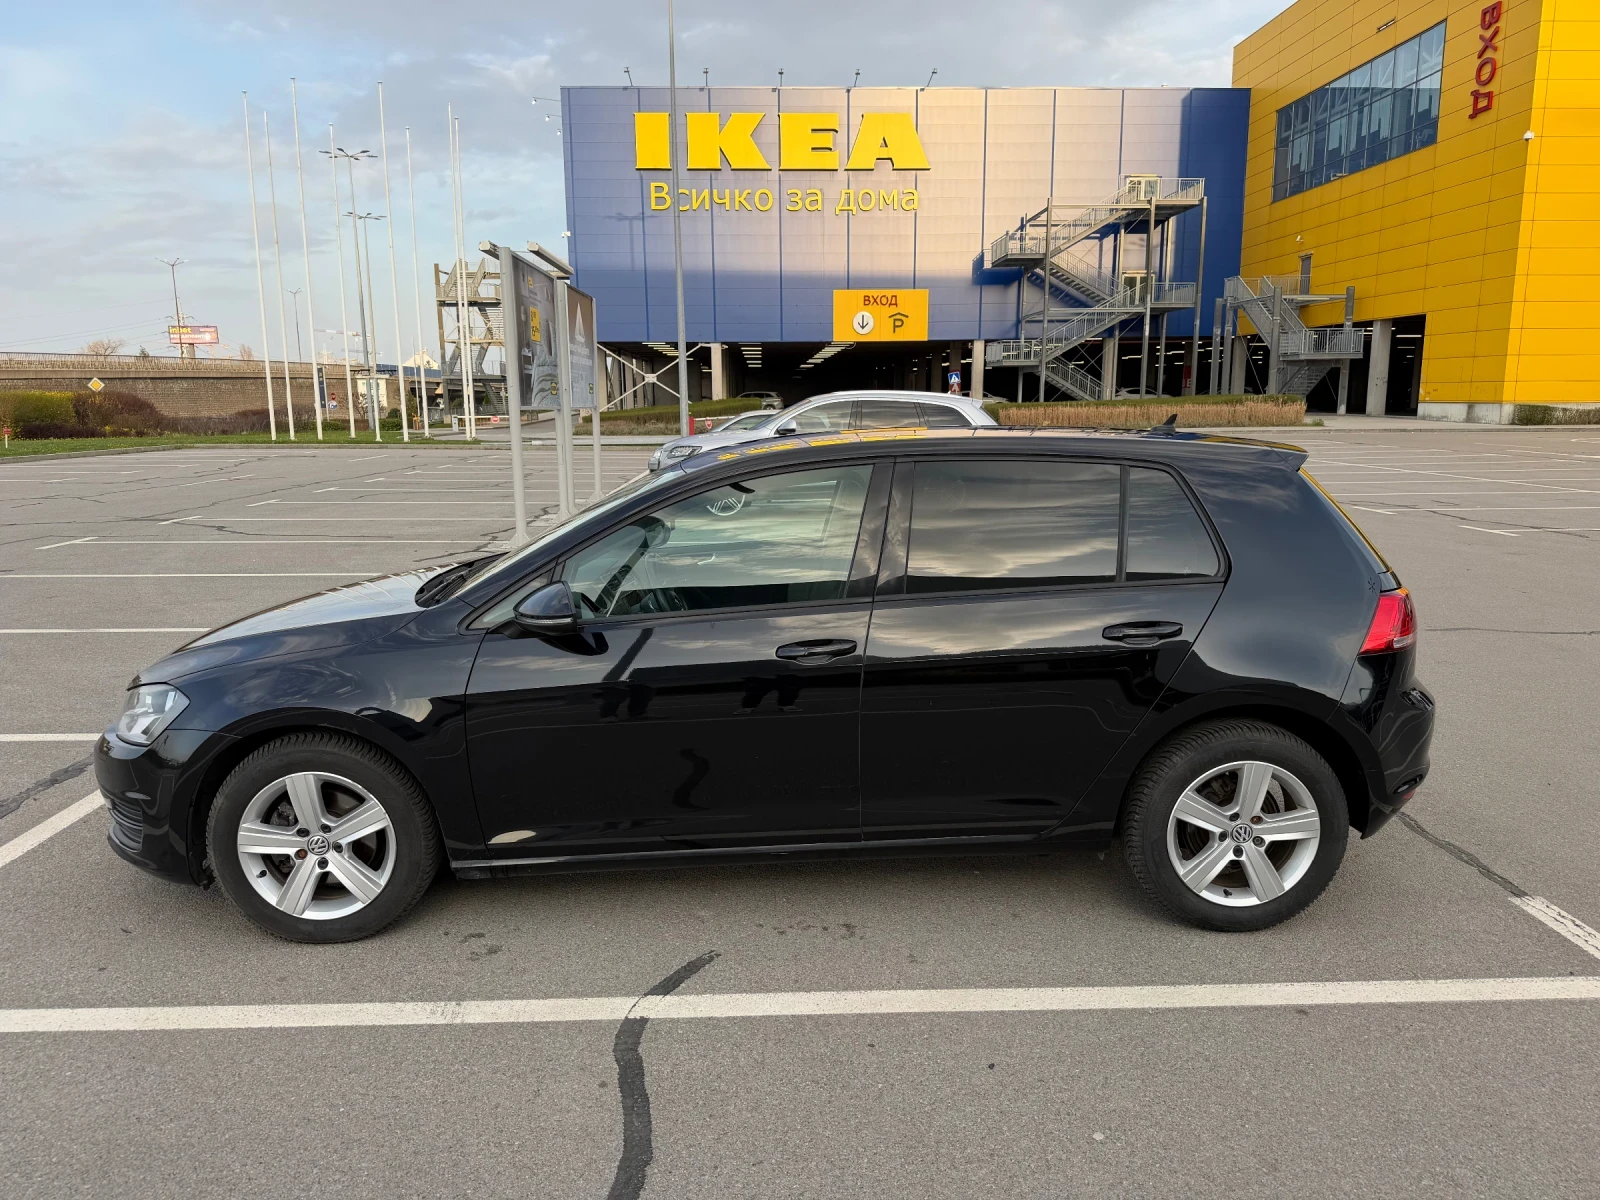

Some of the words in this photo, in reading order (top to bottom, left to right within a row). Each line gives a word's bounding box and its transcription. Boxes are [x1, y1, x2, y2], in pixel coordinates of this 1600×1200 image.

[1468, 1, 1503, 119] ВХОД
[633, 112, 931, 171] IKEA
[650, 182, 774, 212] Всичко
[785, 188, 823, 212] за
[835, 188, 919, 216] дома
[863, 294, 898, 308] ВХОД
